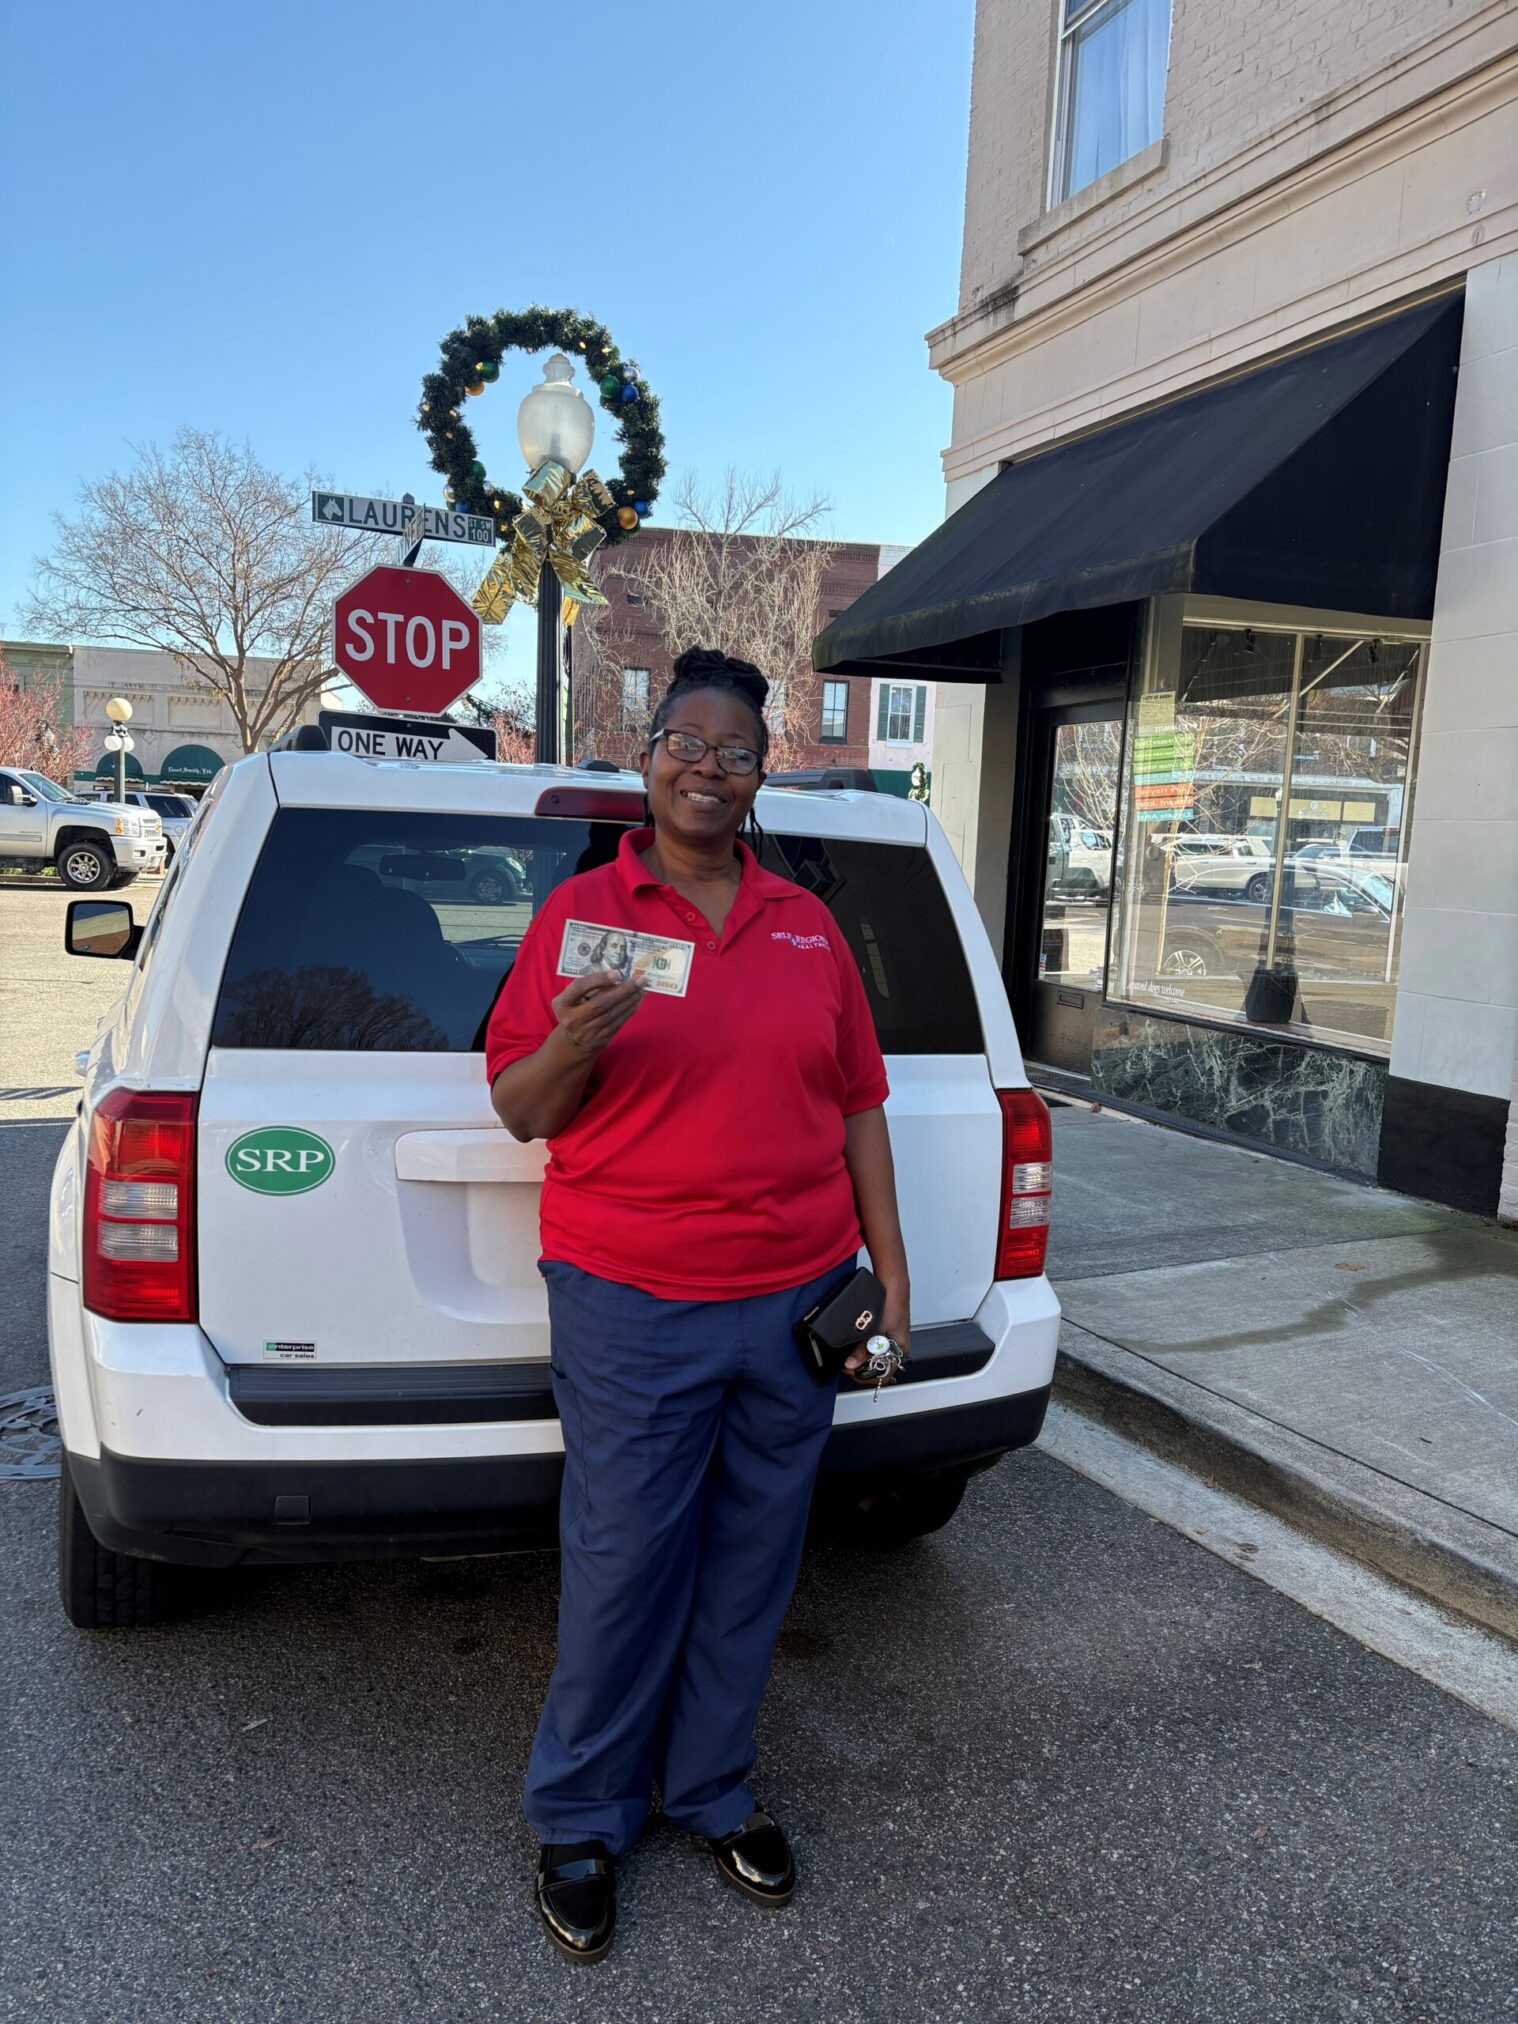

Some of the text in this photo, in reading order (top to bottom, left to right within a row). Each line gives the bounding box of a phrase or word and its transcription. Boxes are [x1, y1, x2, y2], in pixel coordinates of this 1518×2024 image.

[349, 499, 467, 539] LAURENS
[468, 518, 492, 531] ST SW
[471, 529, 489, 543] 100
[345, 608, 471, 671] STOP
[337, 730, 444, 760] ONE WAY
[236, 1148, 325, 1173] SRP
